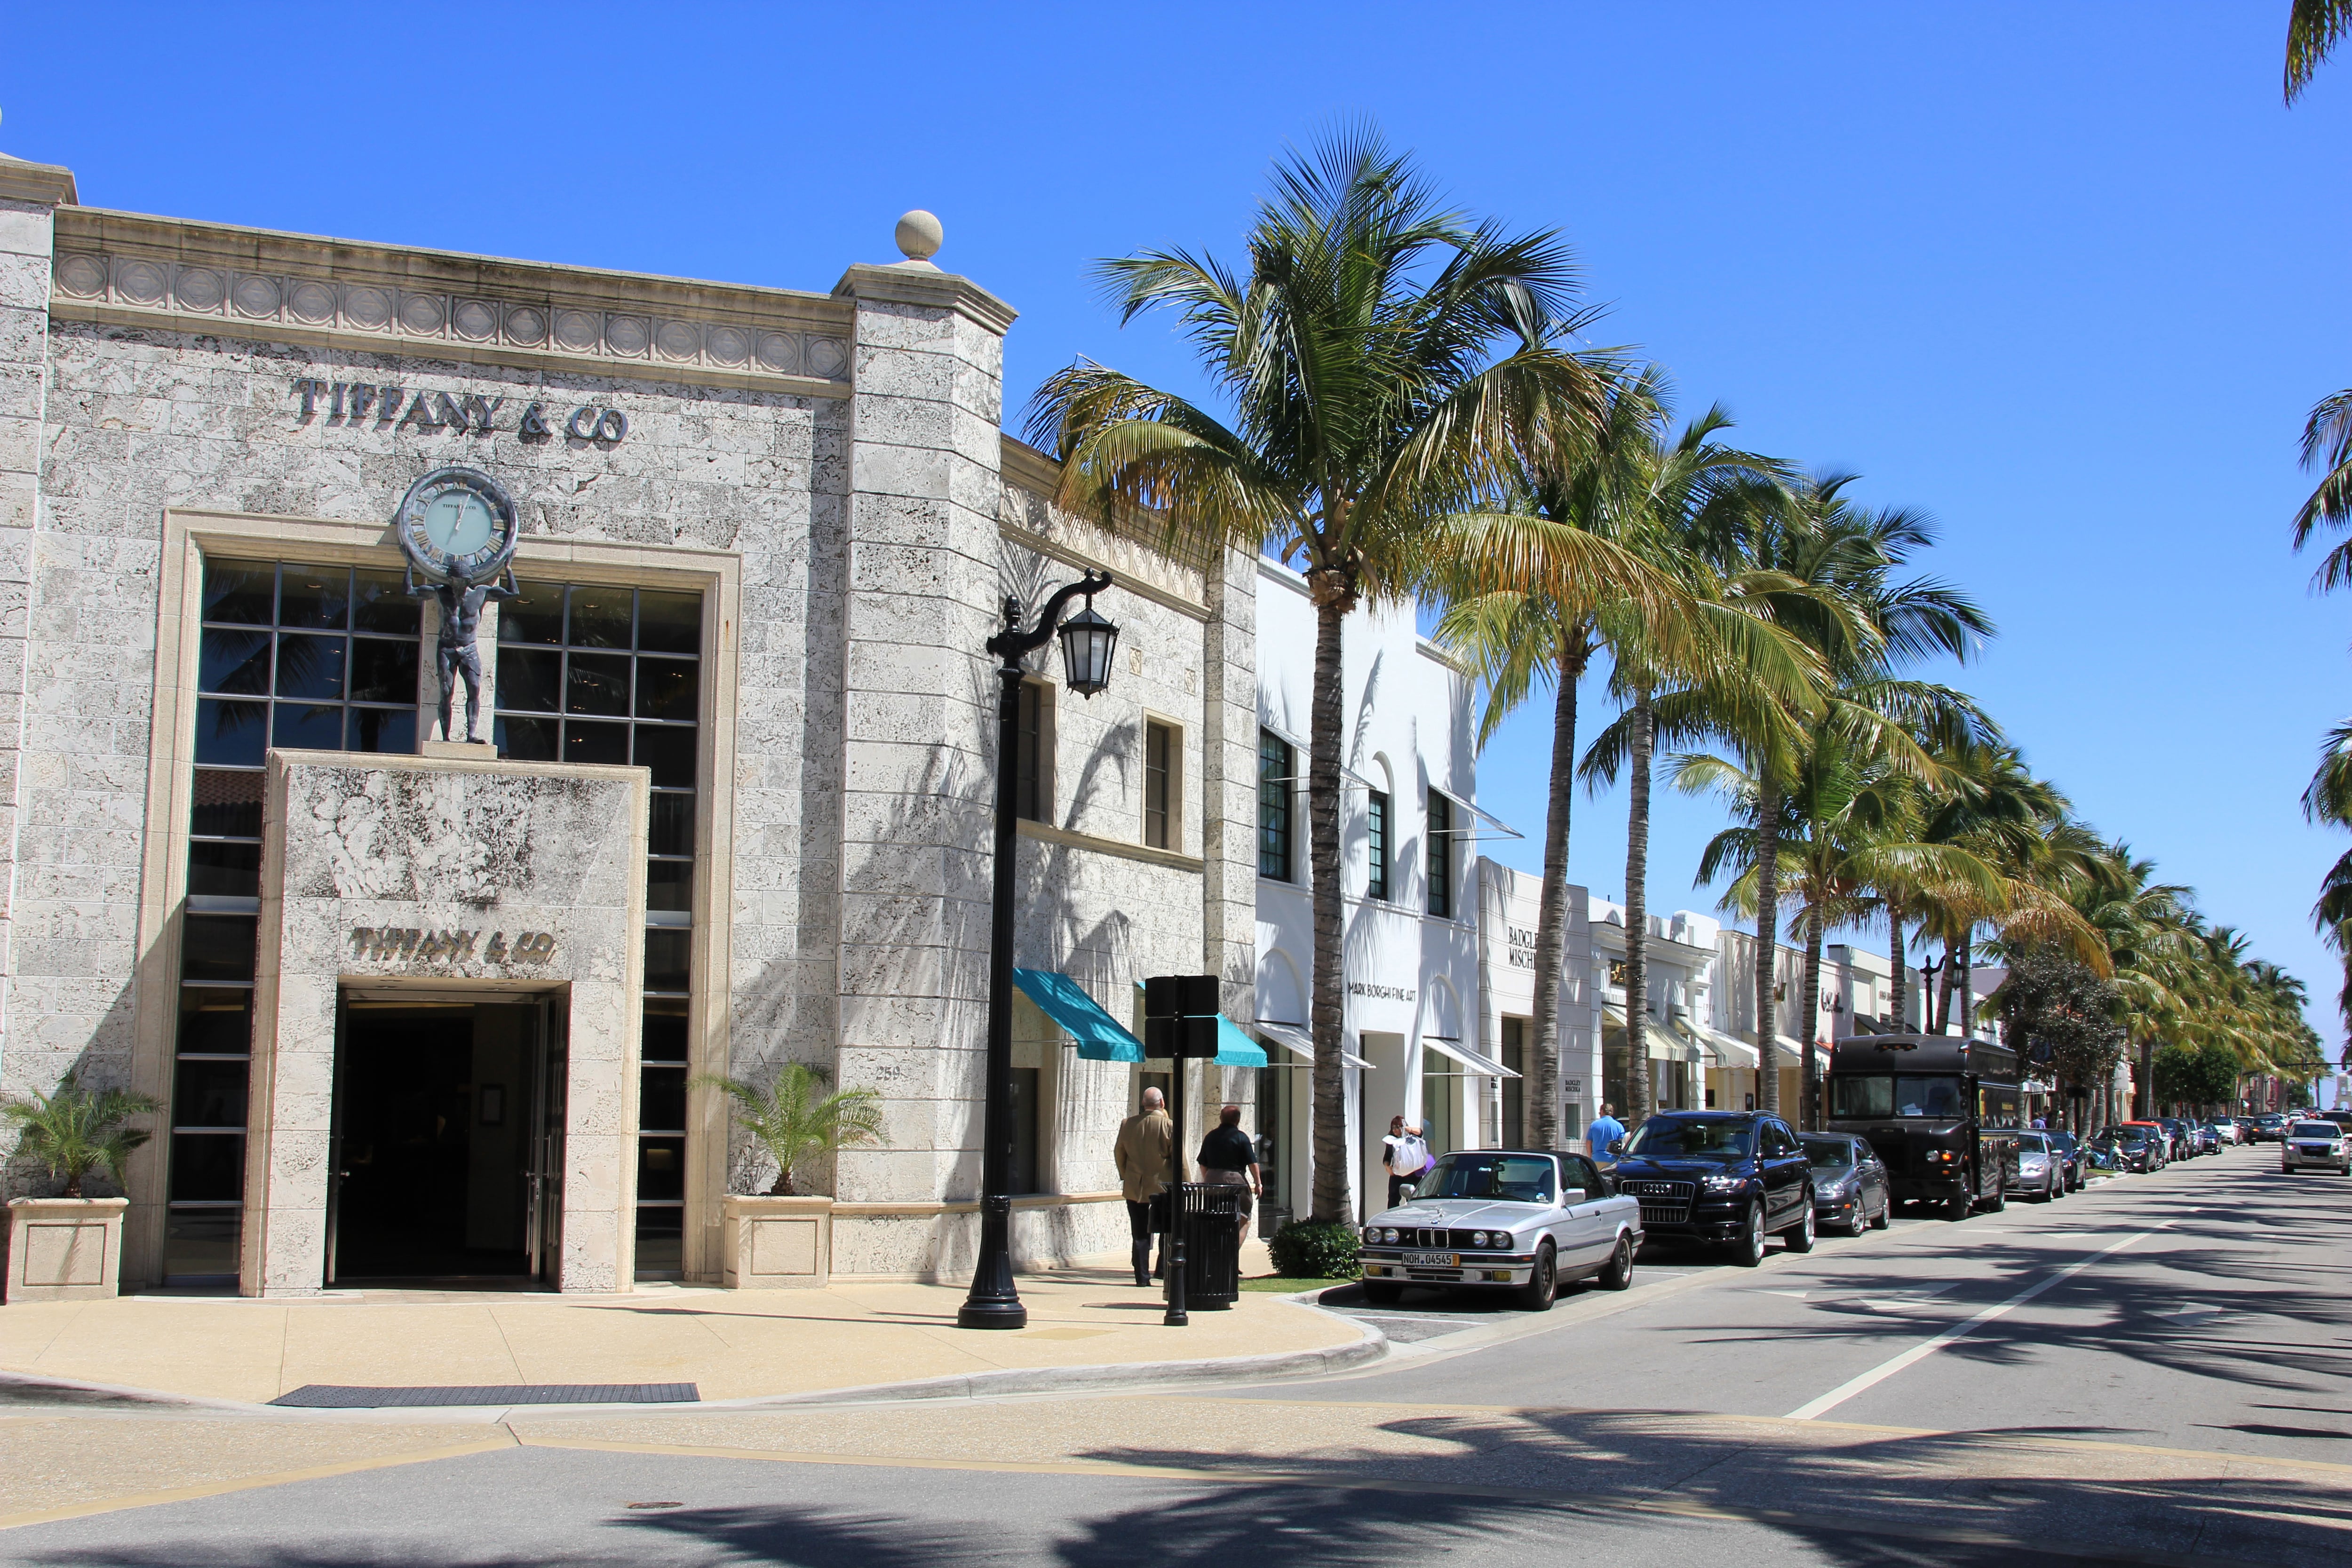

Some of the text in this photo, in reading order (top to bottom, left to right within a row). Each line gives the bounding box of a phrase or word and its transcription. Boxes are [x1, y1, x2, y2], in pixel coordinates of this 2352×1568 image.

[294, 378, 629, 441] TIFFANY & CO
[354, 927, 556, 953] TIFFANY & CO
[1509, 925, 1539, 949] BADGLE
[1348, 982, 1416, 1003] MARK BORGHI FINE ART
[876, 1065, 900, 1080] 259
[1404, 1254, 1420, 1264] NOH
[1425, 1254, 1452, 1265] 04545
